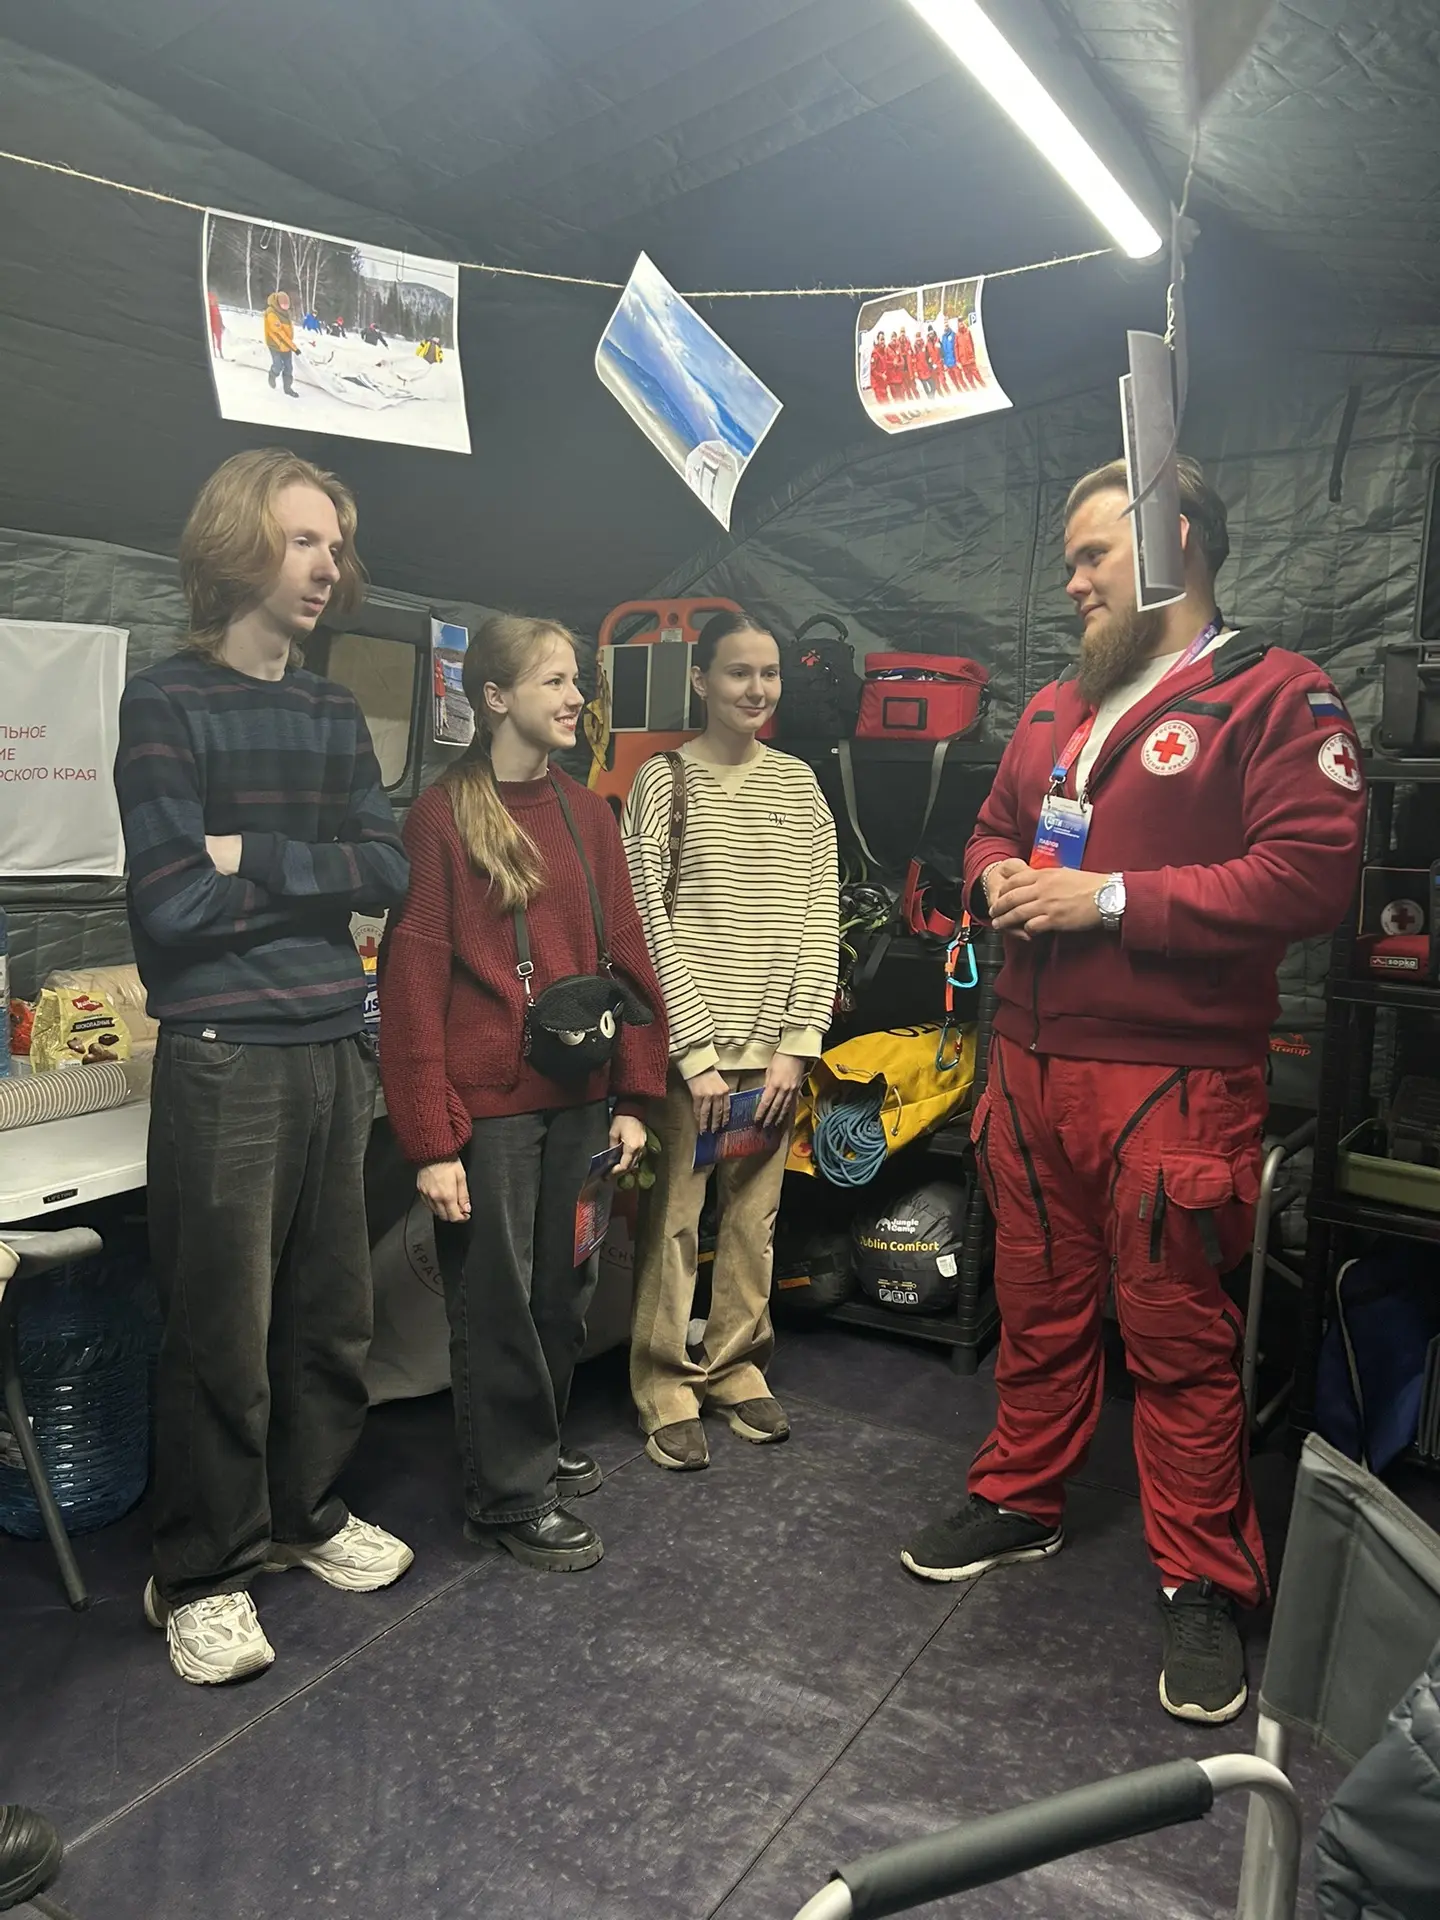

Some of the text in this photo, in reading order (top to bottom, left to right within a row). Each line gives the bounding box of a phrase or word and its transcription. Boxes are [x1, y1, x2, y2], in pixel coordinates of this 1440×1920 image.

[53, 767, 97, 781] КРАЯ
[1387, 958, 1416, 968] sopka
[891, 1218, 919, 1229] Jungle
[891, 1225, 916, 1235] Camp
[890, 1241, 940, 1252] Comfort
